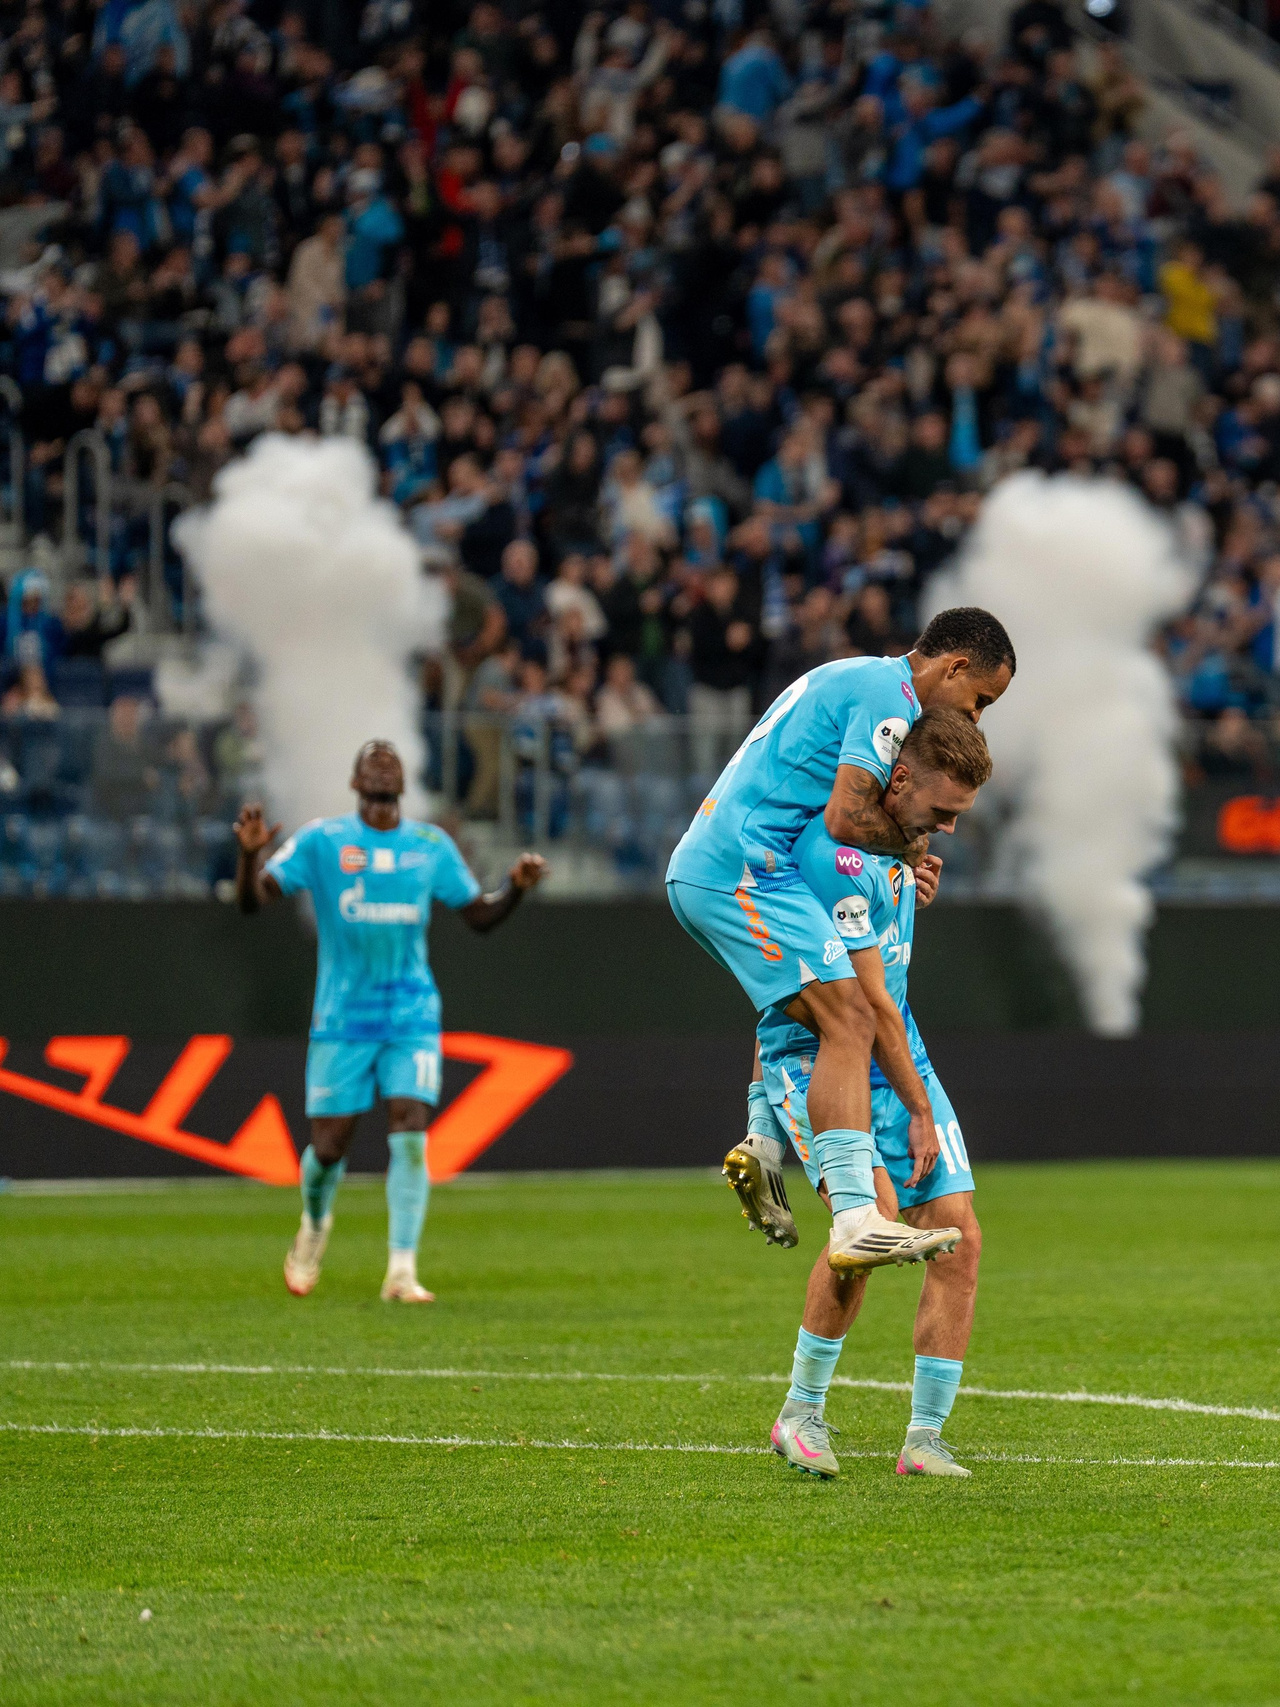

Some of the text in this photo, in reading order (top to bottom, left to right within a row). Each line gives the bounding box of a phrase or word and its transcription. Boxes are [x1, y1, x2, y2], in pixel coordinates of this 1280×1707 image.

[837, 853, 863, 869] wb
[412, 1049, 438, 1091] 11
[934, 1120, 971, 1175] 10
